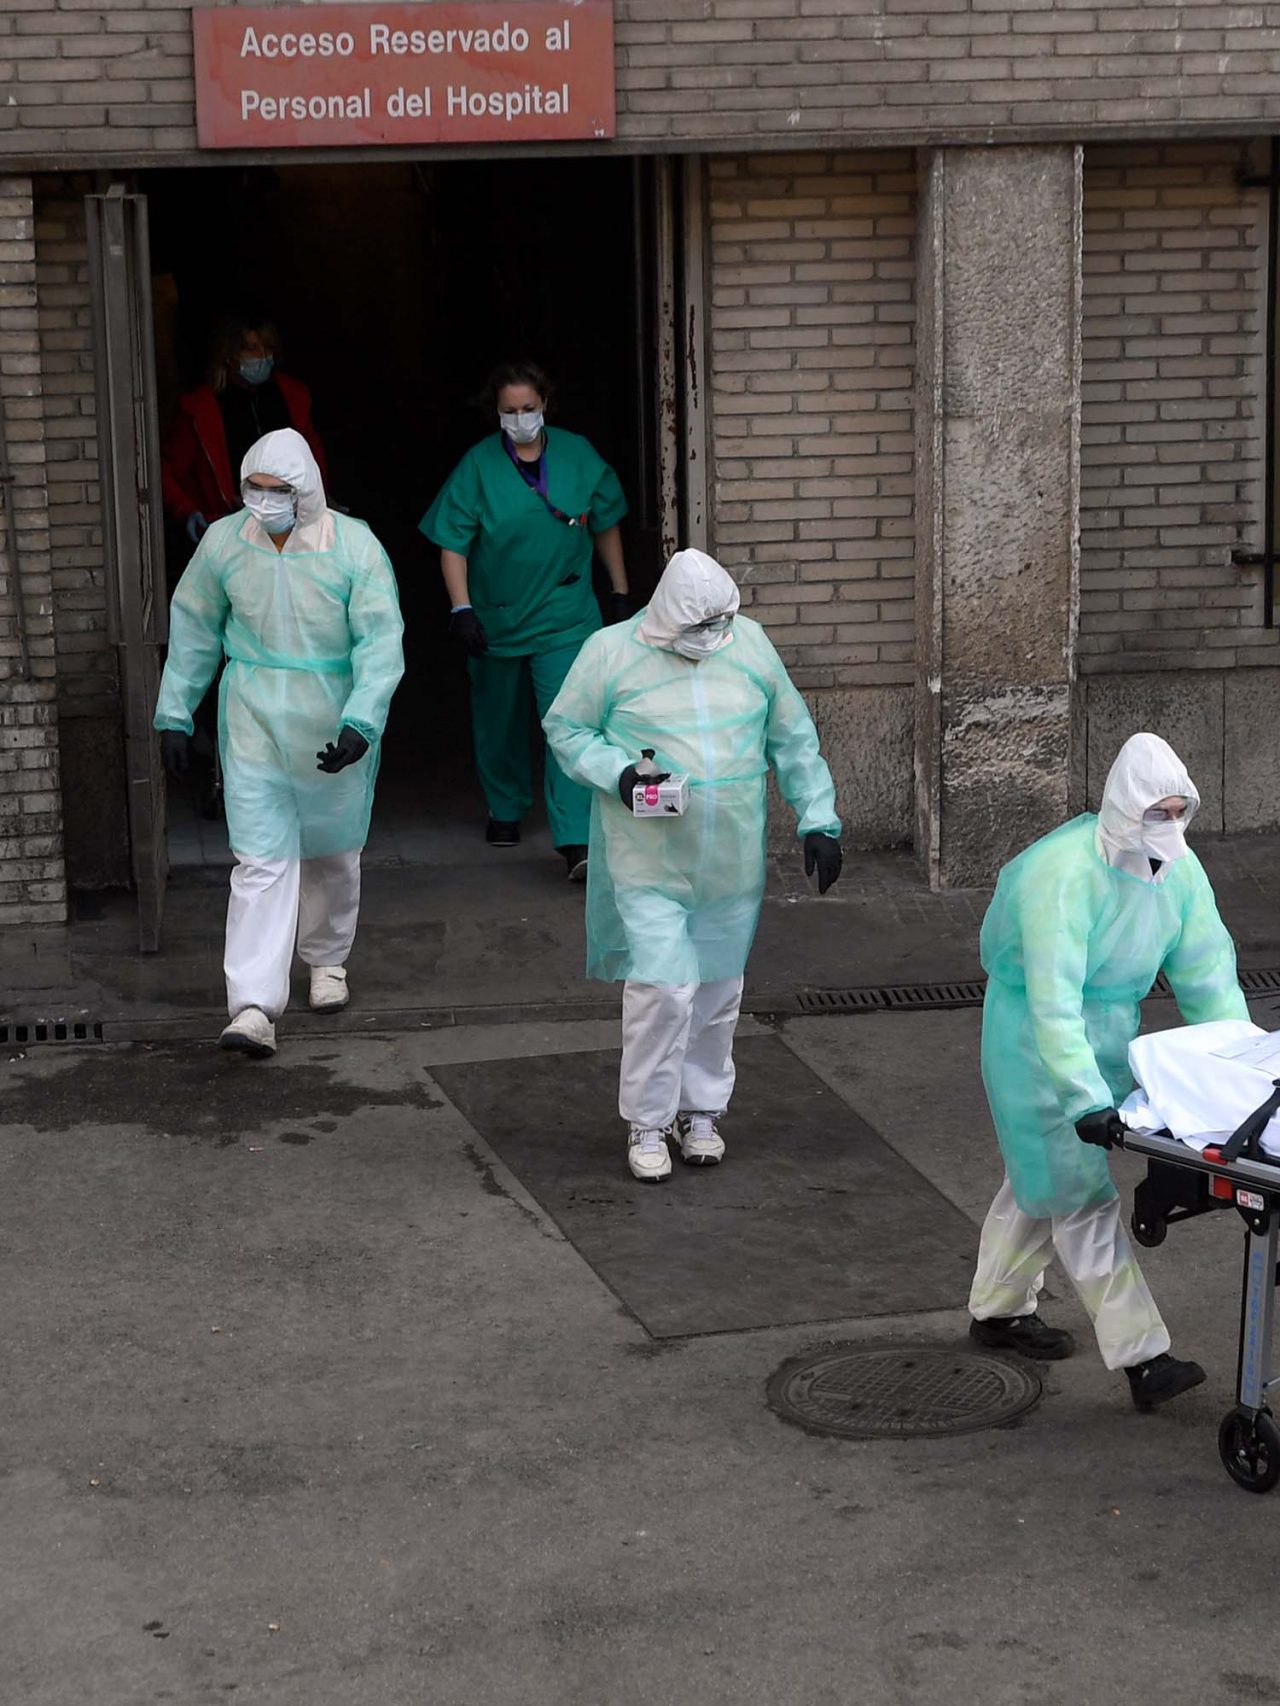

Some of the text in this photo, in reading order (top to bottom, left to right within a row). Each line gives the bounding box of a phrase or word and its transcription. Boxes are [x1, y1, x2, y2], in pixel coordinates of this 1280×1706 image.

[240, 20, 571, 58] Acceso Reservado al
[240, 83, 570, 121] Personal del Hospital
